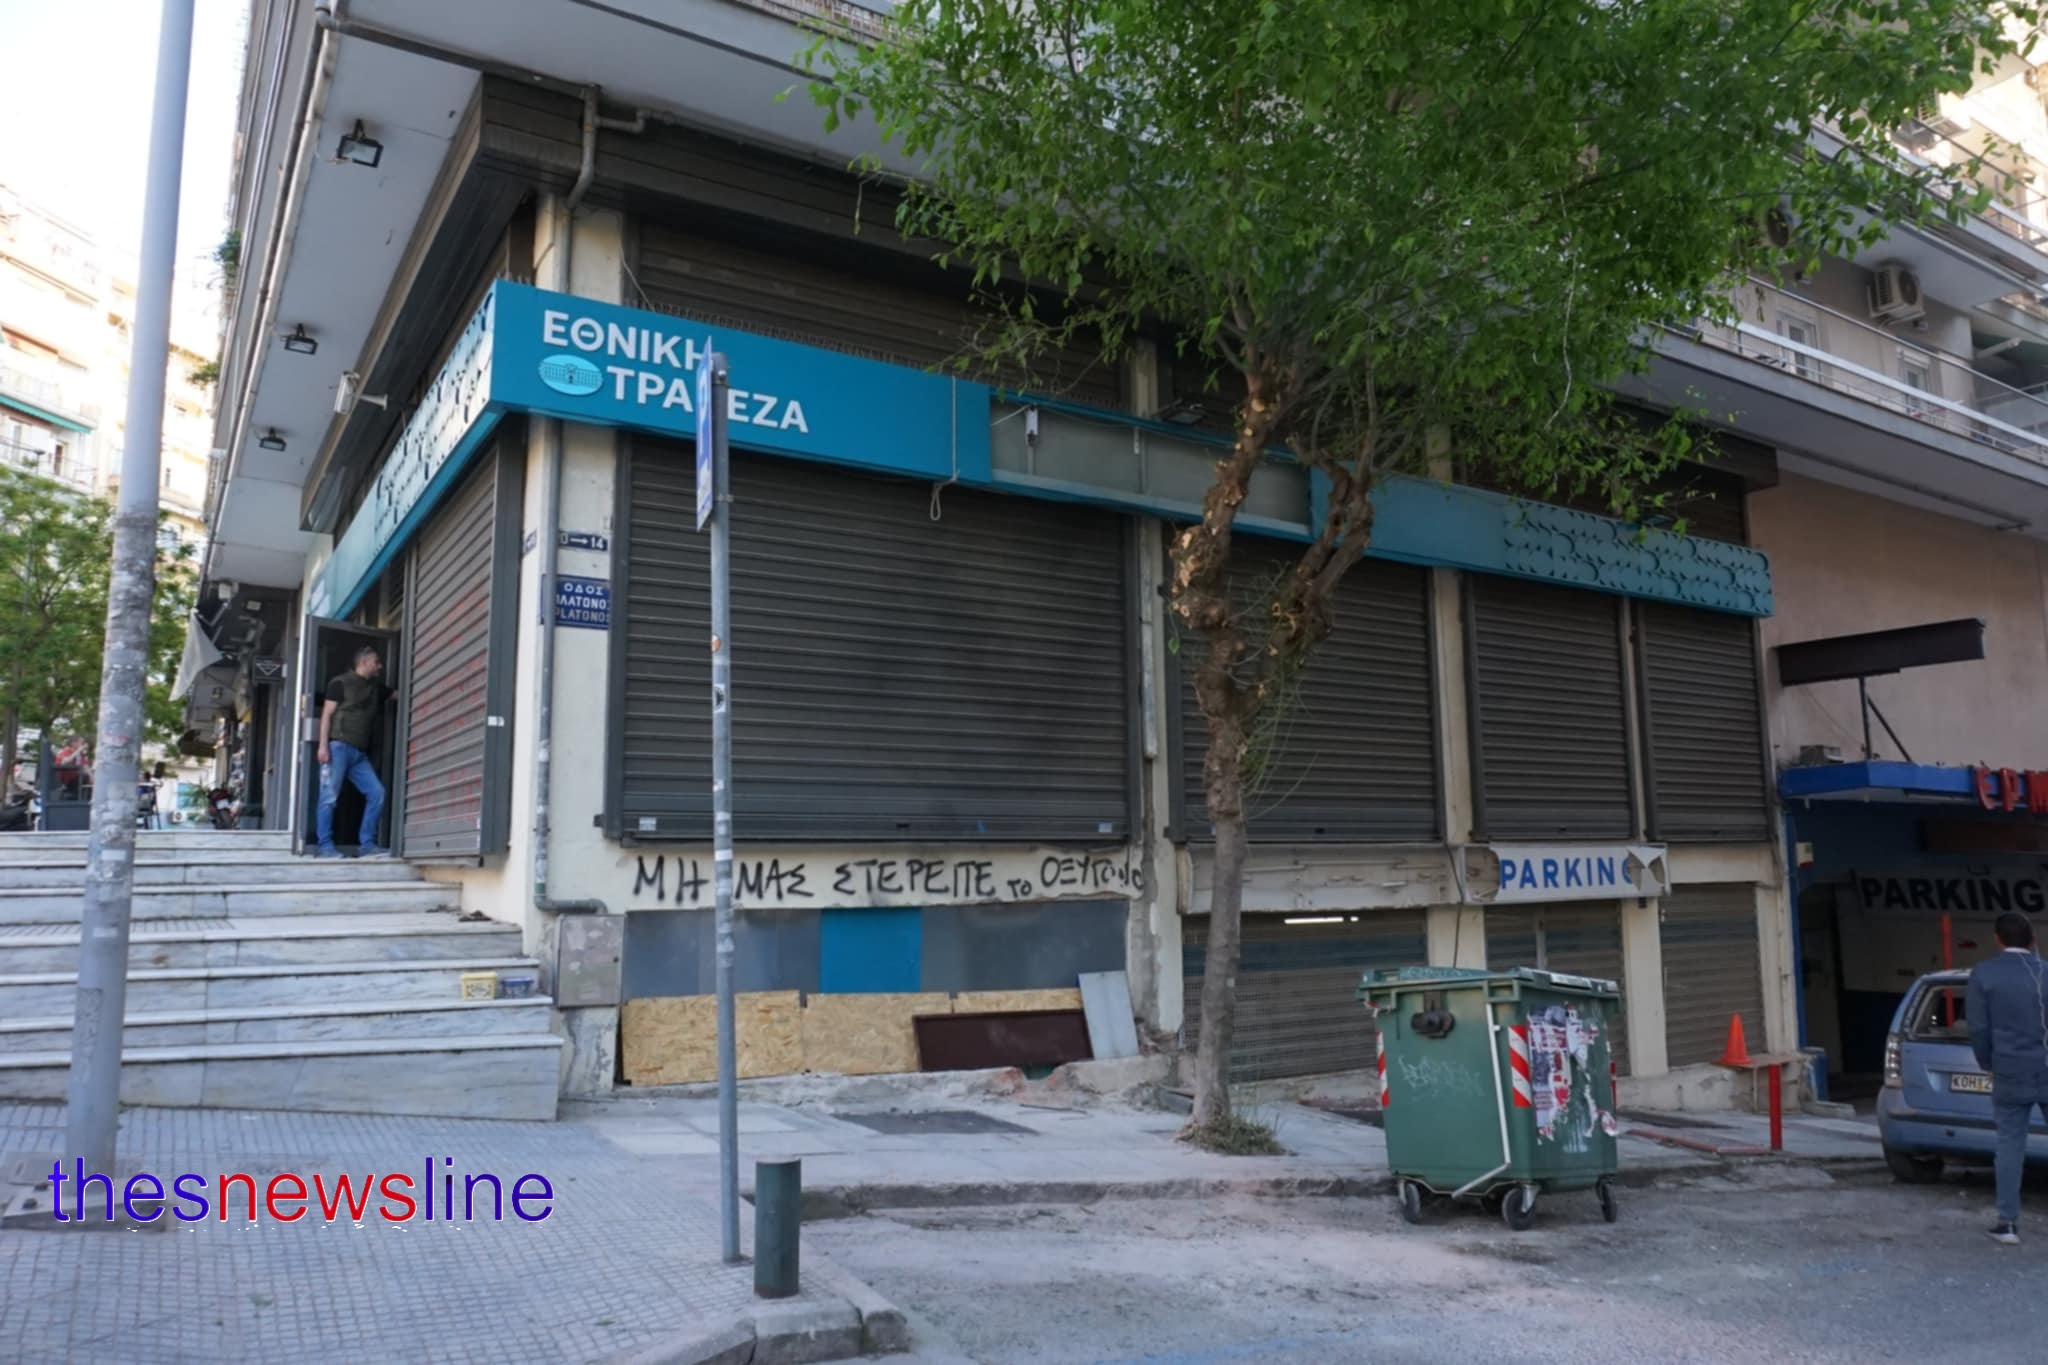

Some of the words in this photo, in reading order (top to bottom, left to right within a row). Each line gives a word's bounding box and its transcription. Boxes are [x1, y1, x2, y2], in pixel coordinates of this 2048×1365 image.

[543, 309, 703, 371] ΕΘΝΙΚΗ
[606, 365, 809, 434] ΤΡΑΕΖΑ
[556, 594, 609, 610] ΛΑΤΩΝΟ
[563, 582, 604, 596] ΟΔΟΣ
[632, 855, 710, 905] ΜΗ
[734, 858, 815, 901] ΜΑΣ
[832, 858, 996, 898] ΣΤΕΡΕΙΤΕ
[1860, 876, 2046, 913] PARKING
